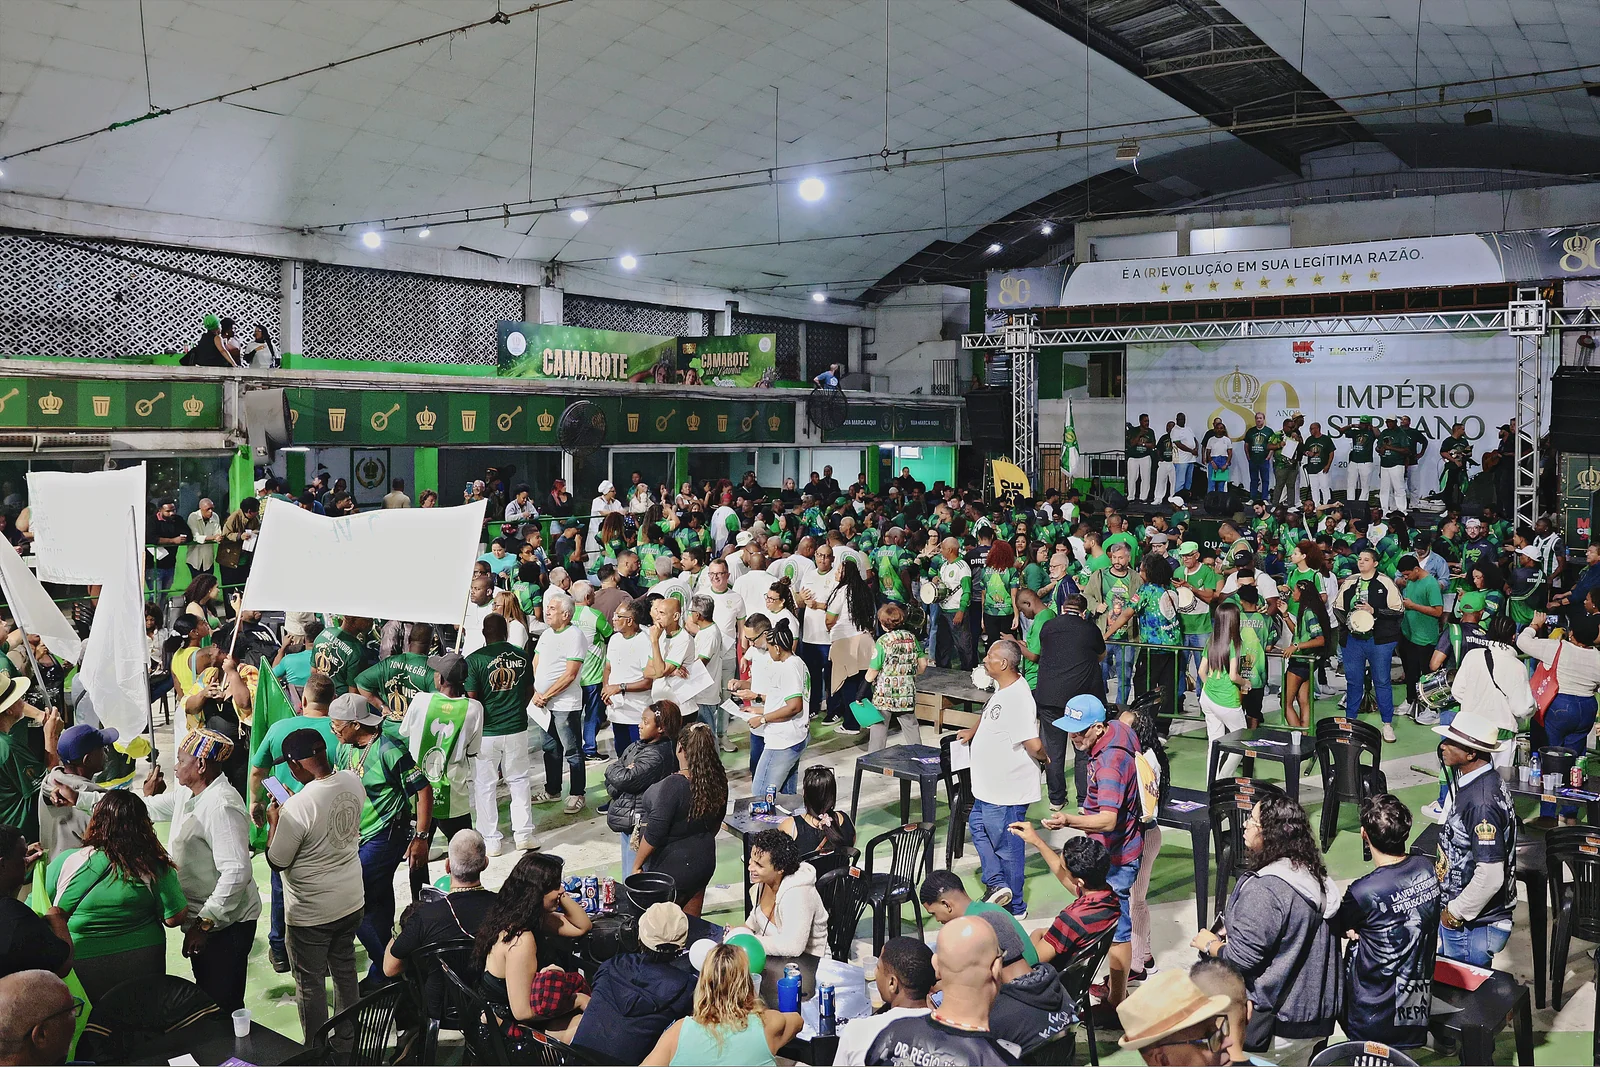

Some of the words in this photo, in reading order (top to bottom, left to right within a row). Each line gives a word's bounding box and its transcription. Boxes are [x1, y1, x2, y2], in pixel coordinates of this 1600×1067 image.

[1122, 266, 1130, 279] É
[1132, 270, 1141, 278] A
[1144, 260, 1233, 278] (R)EVOLUÇÃO
[1237, 260, 1257, 272] EM
[1261, 258, 1289, 271] SUA
[1294, 252, 1363, 269] LEGÍTIMA
[1367, 246, 1425, 264] RAZÃO.
[1292, 341, 1315, 352] MK
[542, 348, 628, 379] CAMAROTE
[701, 352, 749, 368] CAMAROTE
[1337, 379, 1475, 409] IMPÉRIO
[404, 662, 427, 676] NEGÃO
[1392, 904, 1405, 914] EM
[1403, 897, 1424, 911] BUSCA
[1423, 892, 1432, 904] DO
[1400, 886, 1415, 899] VEM
[893, 1041, 908, 1058] DR.
[908, 1047, 940, 1066] RÉGIO
